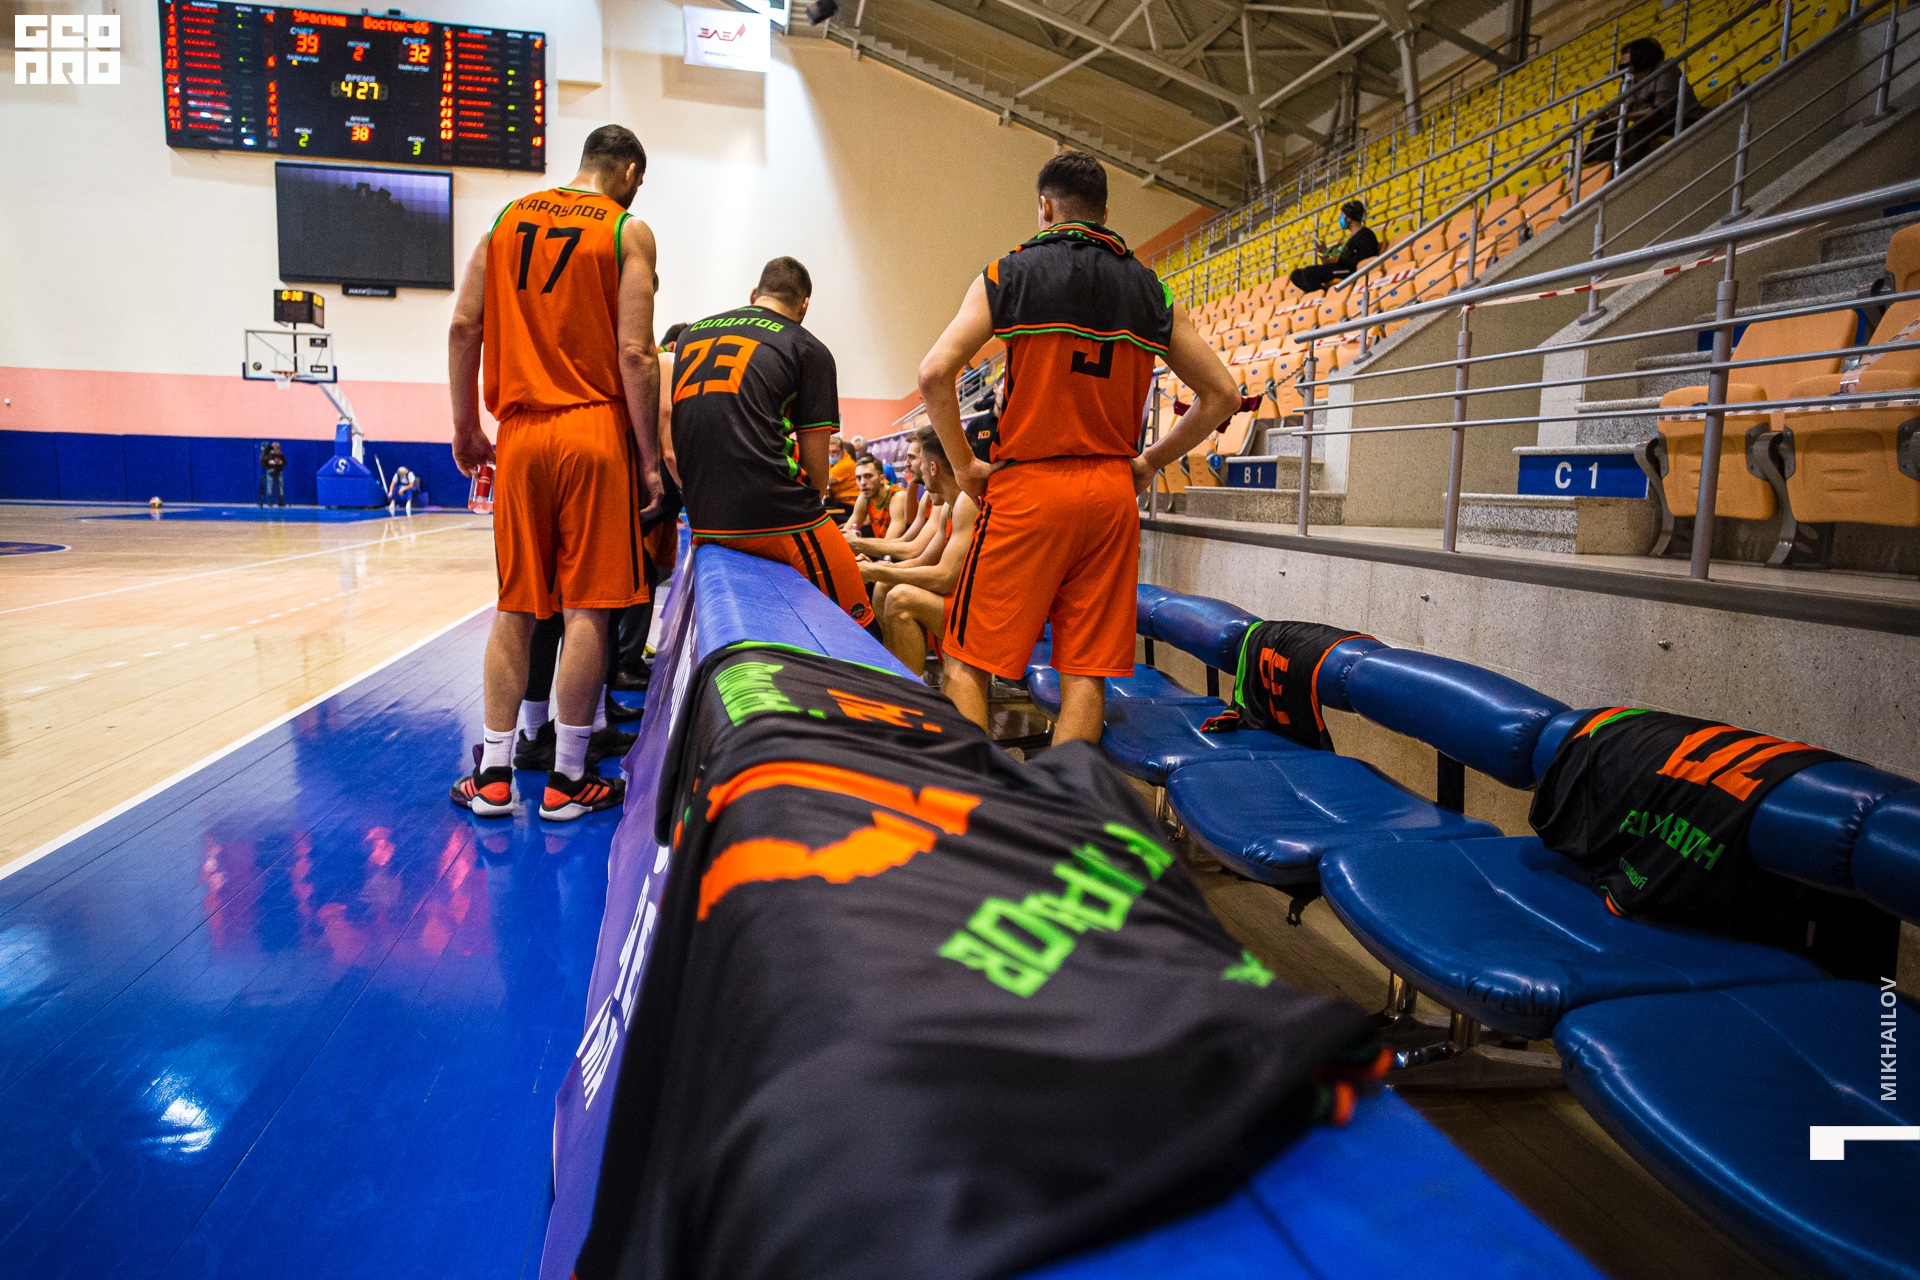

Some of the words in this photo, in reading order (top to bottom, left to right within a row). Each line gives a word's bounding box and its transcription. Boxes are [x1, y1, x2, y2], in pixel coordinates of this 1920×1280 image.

[292, 9, 348, 27] Уралмаш
[362, 15, 430, 35] Восток-65
[296, 33, 320, 54] 39
[353, 46, 365, 61] 2
[408, 44, 432, 64] 32
[299, 133, 309, 147] 2
[351, 125, 371, 142] 38
[412, 141, 421, 155] 3
[516, 199, 608, 221] КАРАУЛОВ
[515, 221, 585, 295] 17
[690, 317, 785, 333] СОЛДАТОВ
[673, 335, 761, 405] 23
[1244, 466, 1252, 484] B
[1257, 467, 1262, 484] 1
[1554, 462, 1572, 489] C
[1588, 462, 1599, 489] 1
